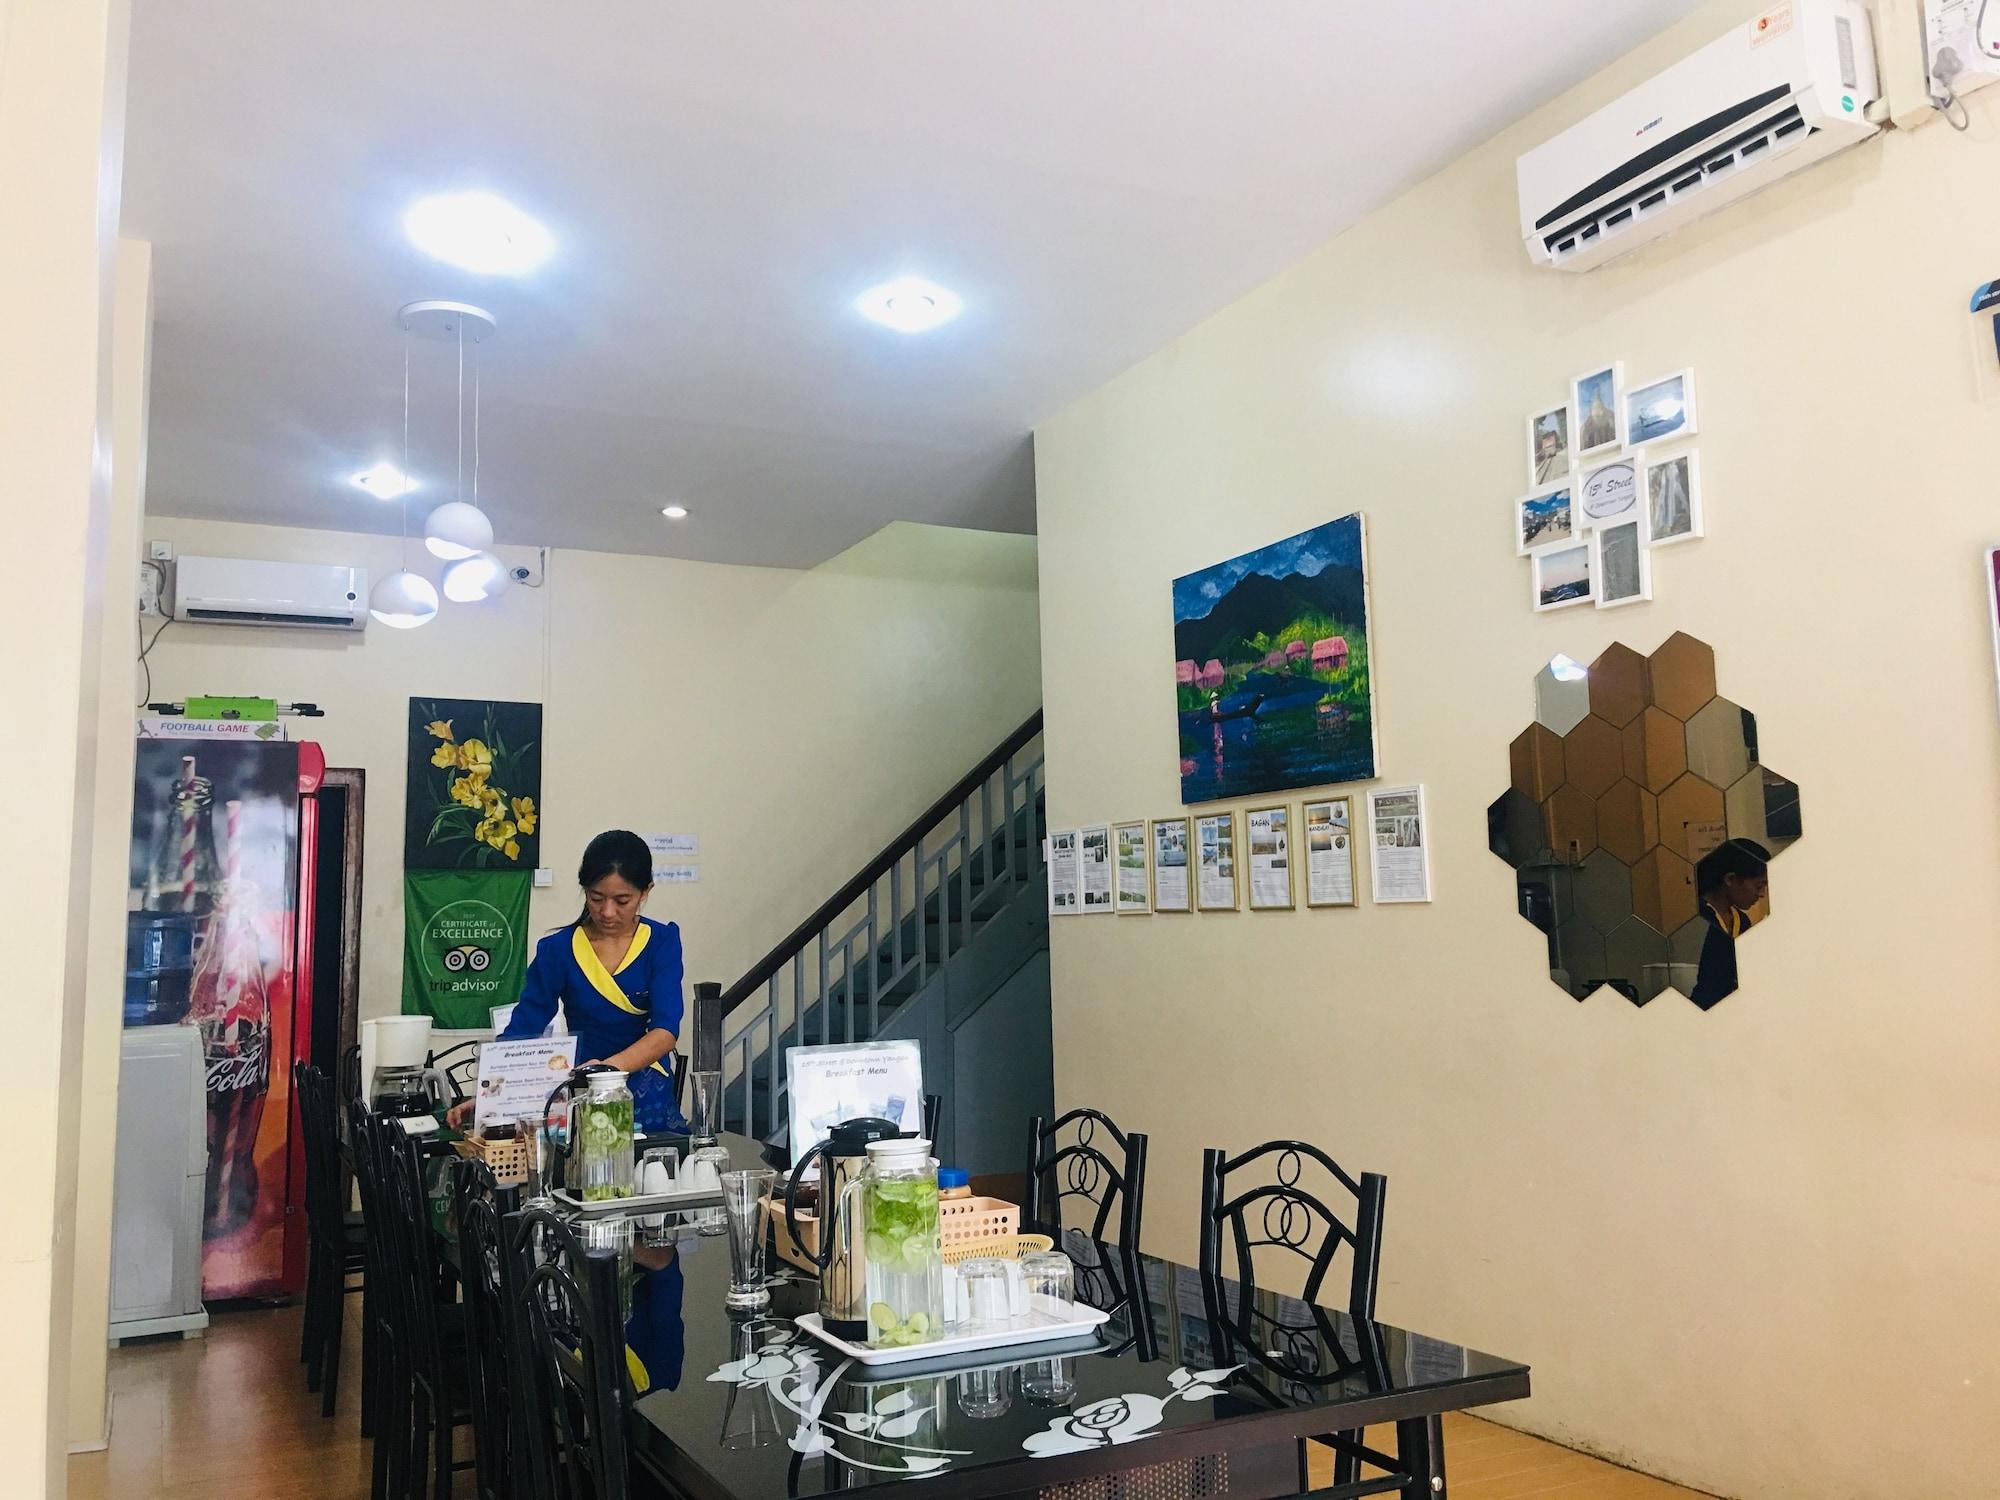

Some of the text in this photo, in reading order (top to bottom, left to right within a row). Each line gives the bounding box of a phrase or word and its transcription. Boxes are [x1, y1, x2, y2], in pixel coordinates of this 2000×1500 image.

[1605, 476, 1633, 493] Street
[160, 722, 250, 733] FOOTBALL GAME
[440, 920, 488, 928] CERTIFICATE
[432, 928, 503, 939] EXCELLENCE
[429, 978, 501, 994] tripadvisor
[504, 1050, 536, 1058] Breakfast
[206, 1046, 263, 1092] Cola
[825, 1067, 888, 1078] Breakfast Menu
